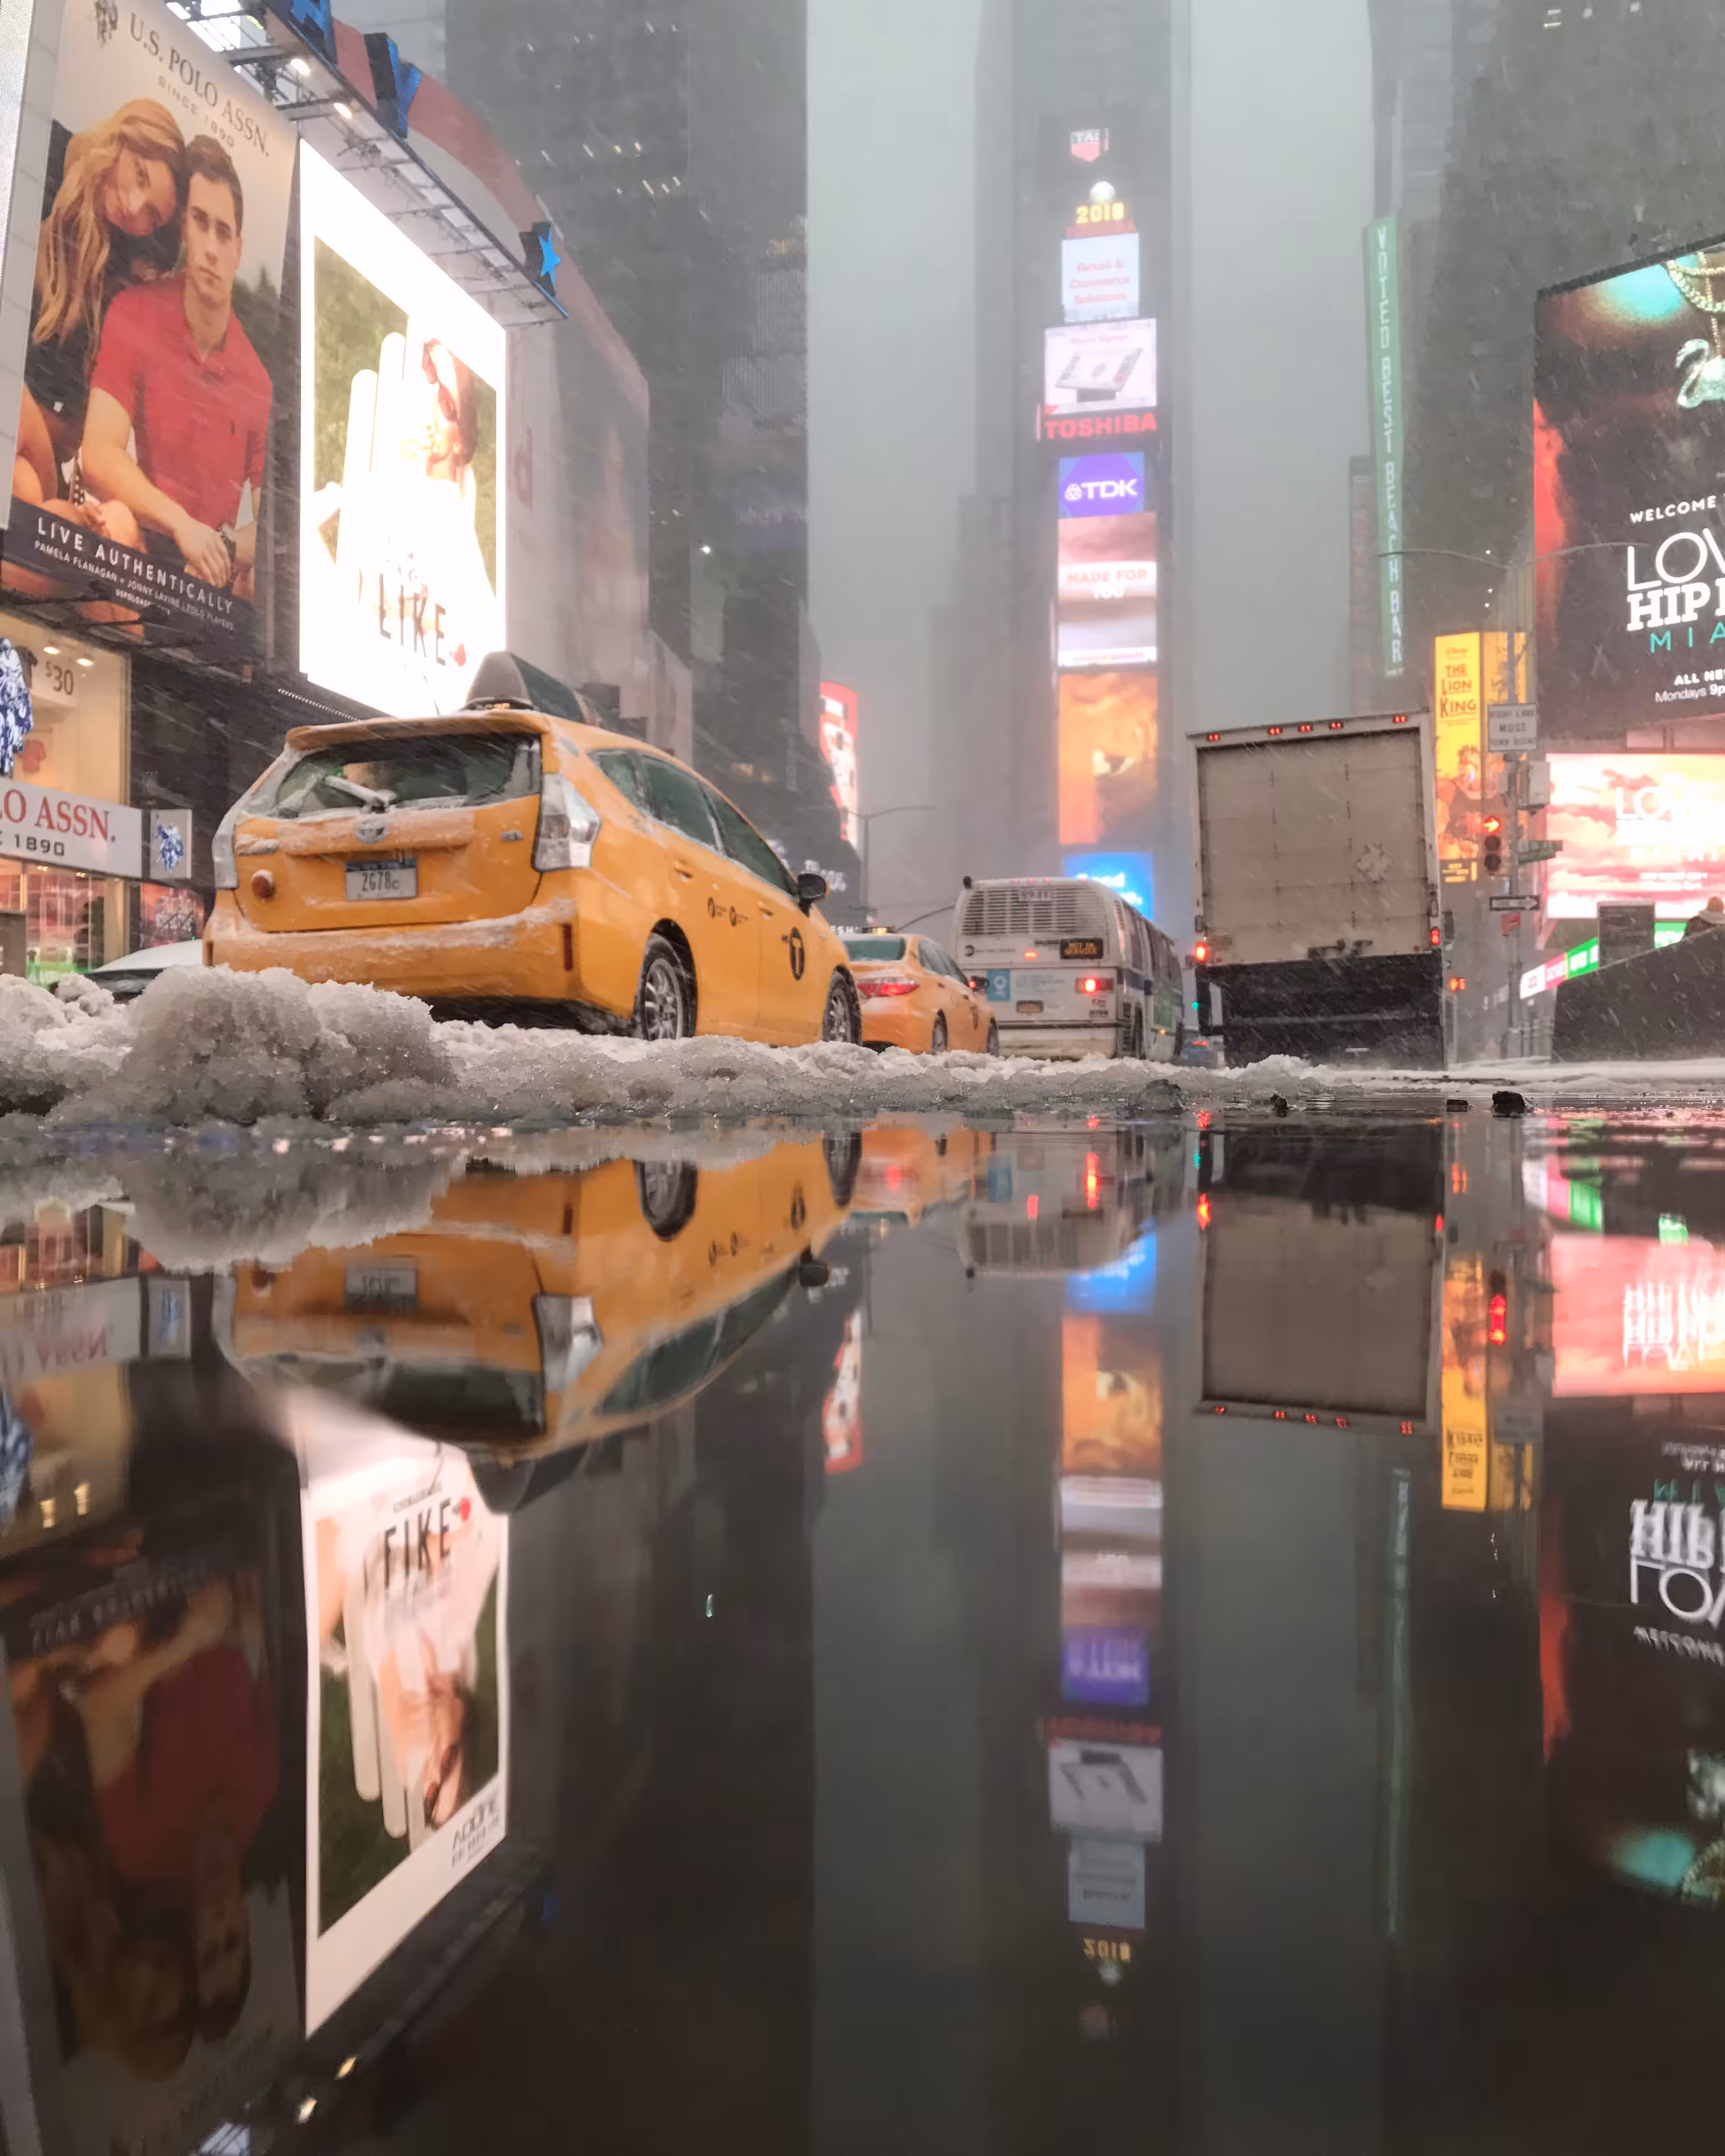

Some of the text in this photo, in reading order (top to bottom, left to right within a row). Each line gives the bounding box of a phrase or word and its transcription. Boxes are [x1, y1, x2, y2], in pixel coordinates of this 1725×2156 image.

[129, 13, 270, 157] U.S. POLO ASSN.
[158, 76, 234, 148] SINCE 1890
[1044, 412, 1158, 440] TOSHIBA
[1082, 479, 1139, 499] TDK
[1629, 495, 1717, 524] WELCOME
[34, 540, 70, 563] PAMELA
[73, 556, 118, 582] FLANAGAN
[37, 517, 233, 615] LIVE AUTHENTICALLY
[1067, 568, 1148, 584] MADE FOR
[379, 573, 446, 667] LIKE
[1627, 582, 1711, 631] HIP
[1390, 590, 1402, 663] BAR
[46, 660, 74, 695] $30
[1446, 663, 1467, 677] THE
[1674, 668, 1725, 686] ALL NE
[1441, 678, 1472, 695] LION
[1655, 683, 1725, 703] Mondays 9p
[1440, 697, 1477, 719] KING
[1499, 722, 1525, 733] MUST
[34, 796, 116, 843] ASSN.
[14, 833, 64, 857] 1890
